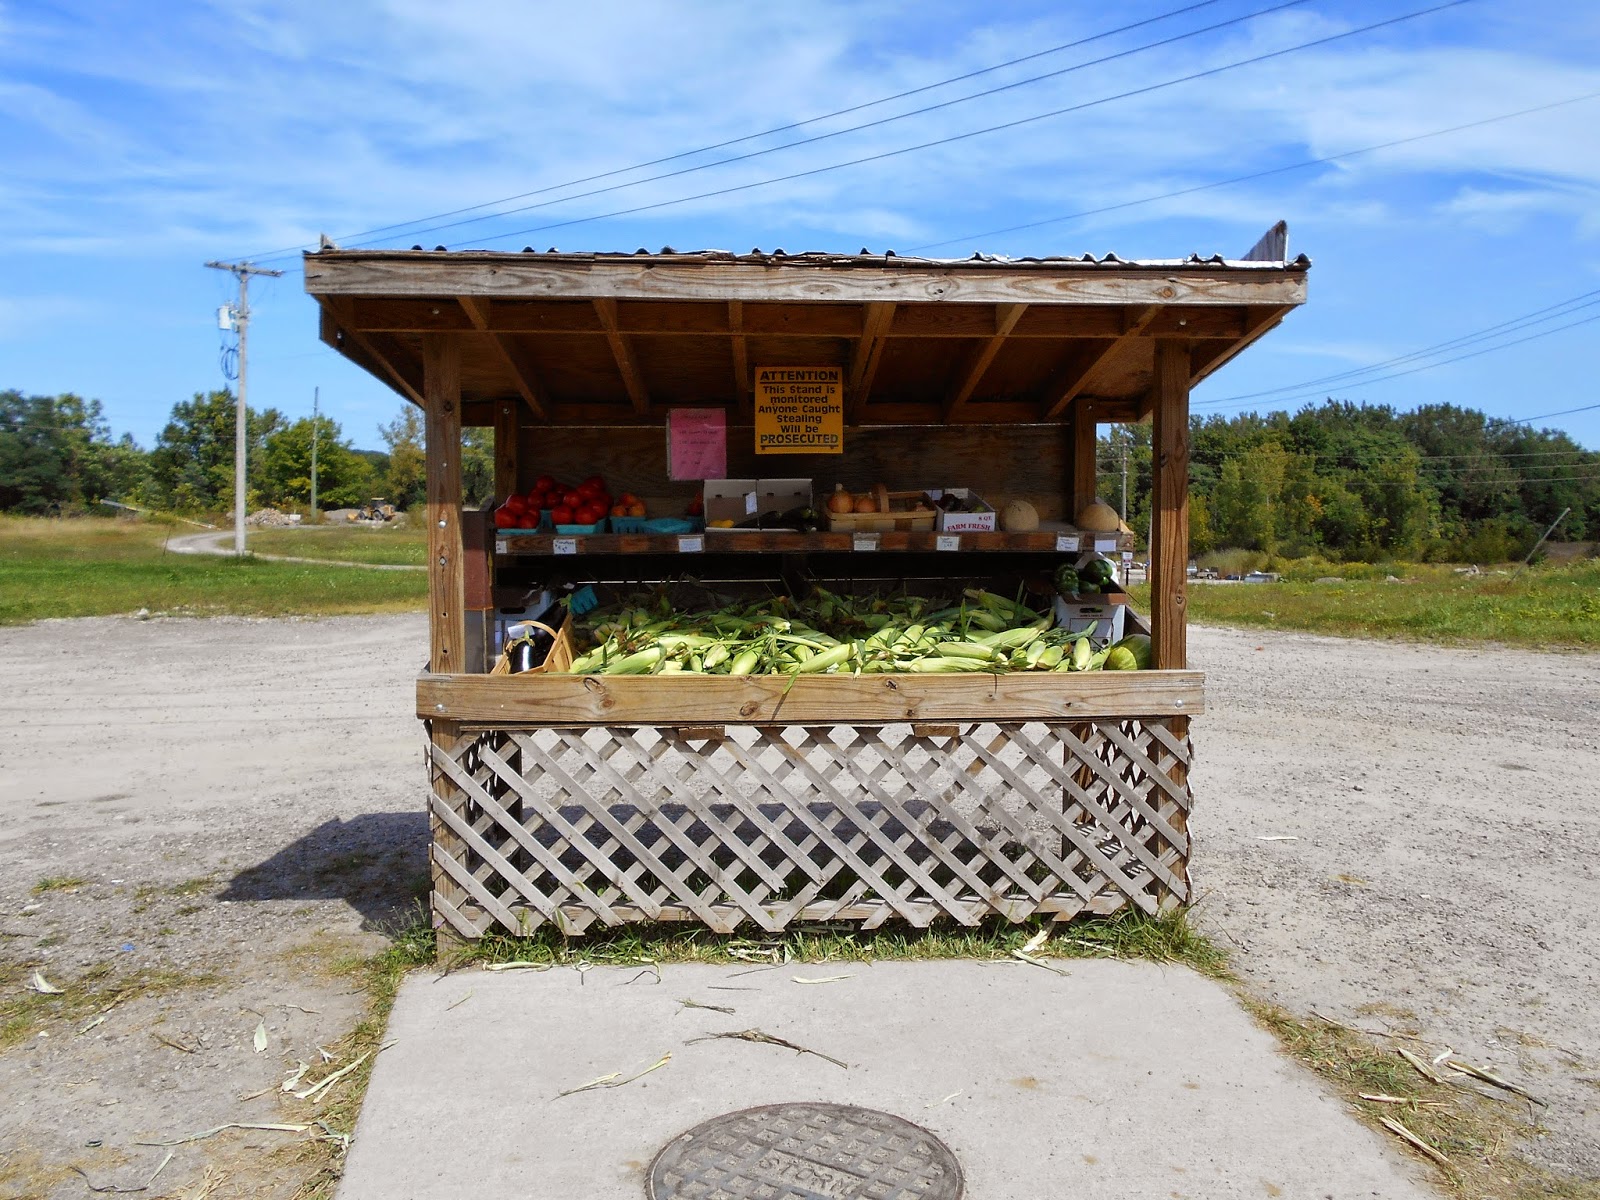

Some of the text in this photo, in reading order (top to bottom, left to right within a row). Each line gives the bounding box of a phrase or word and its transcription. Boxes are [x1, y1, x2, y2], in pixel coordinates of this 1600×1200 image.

[760, 371, 838, 380] ATTENTION
[763, 386, 835, 394] This Stand is
[770, 395, 828, 404] monitored
[759, 405, 840, 414] Anyone Caught
[777, 415, 822, 424] Stealing
[781, 425, 818, 433] Will be
[760, 434, 838, 444] PROSECUTED
[947, 523, 991, 531] FARM FRESH
[759, 1157, 860, 1198] STORM
